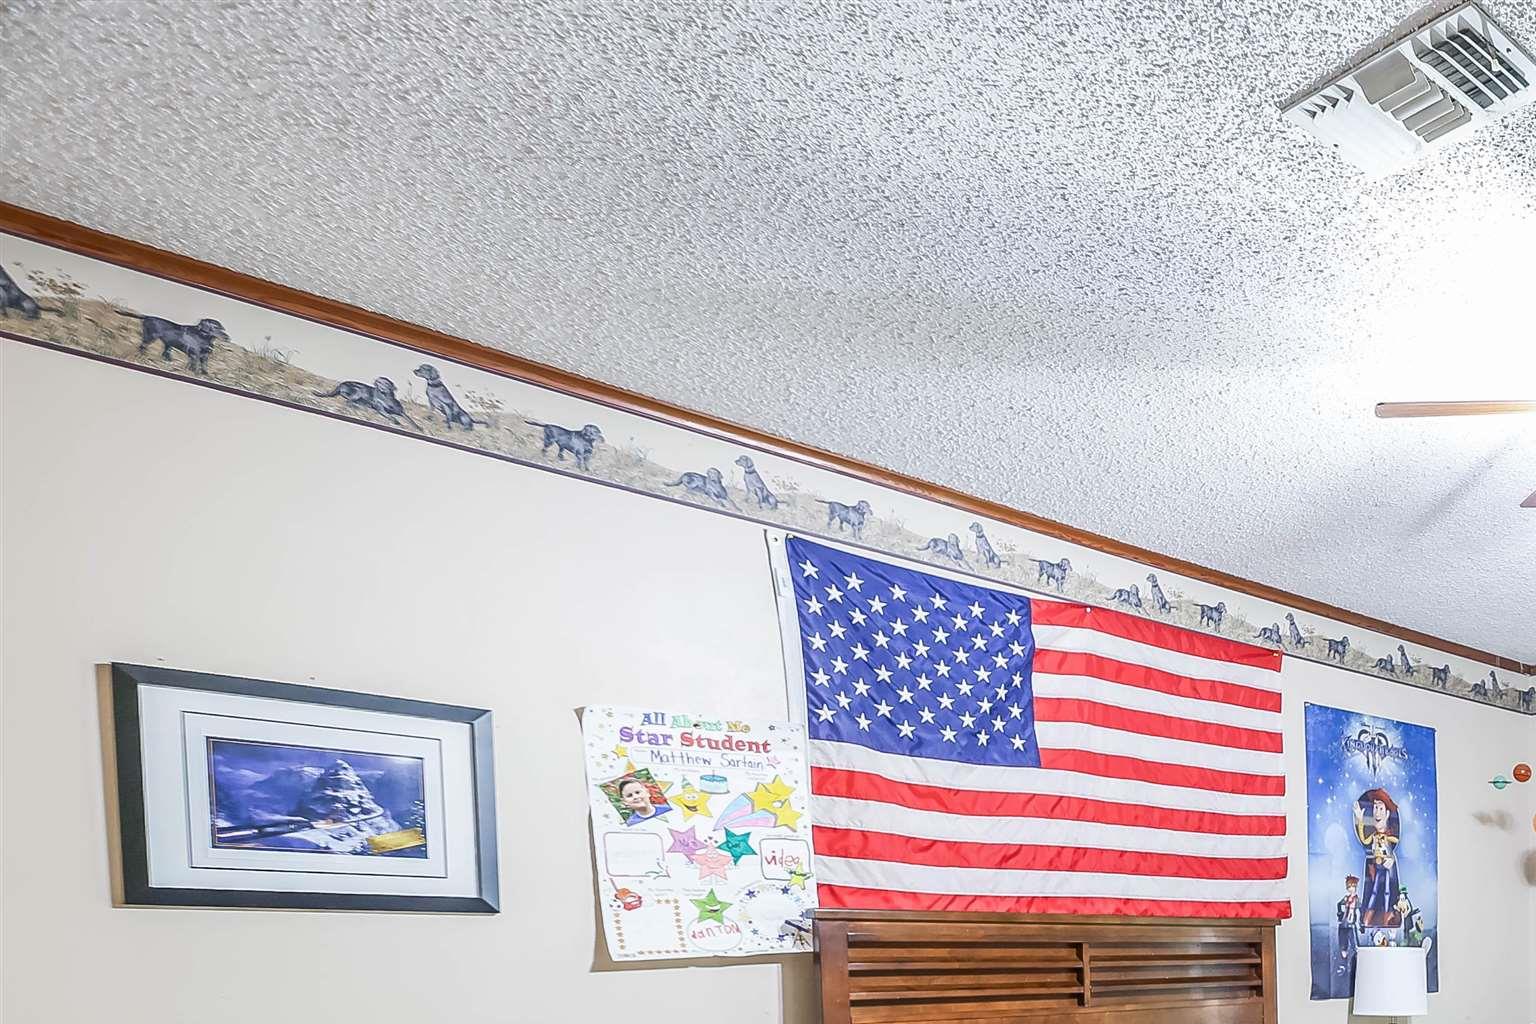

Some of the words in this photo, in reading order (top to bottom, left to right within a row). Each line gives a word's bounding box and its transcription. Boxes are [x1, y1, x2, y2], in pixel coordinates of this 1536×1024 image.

[640, 711, 666, 726] All
[726, 720, 751, 733] Me
[619, 726, 673, 746] Star
[680, 731, 772, 754] Student
[650, 749, 712, 767] Matthew
[720, 752, 765, 770] Sartain
[764, 848, 801, 868] video
